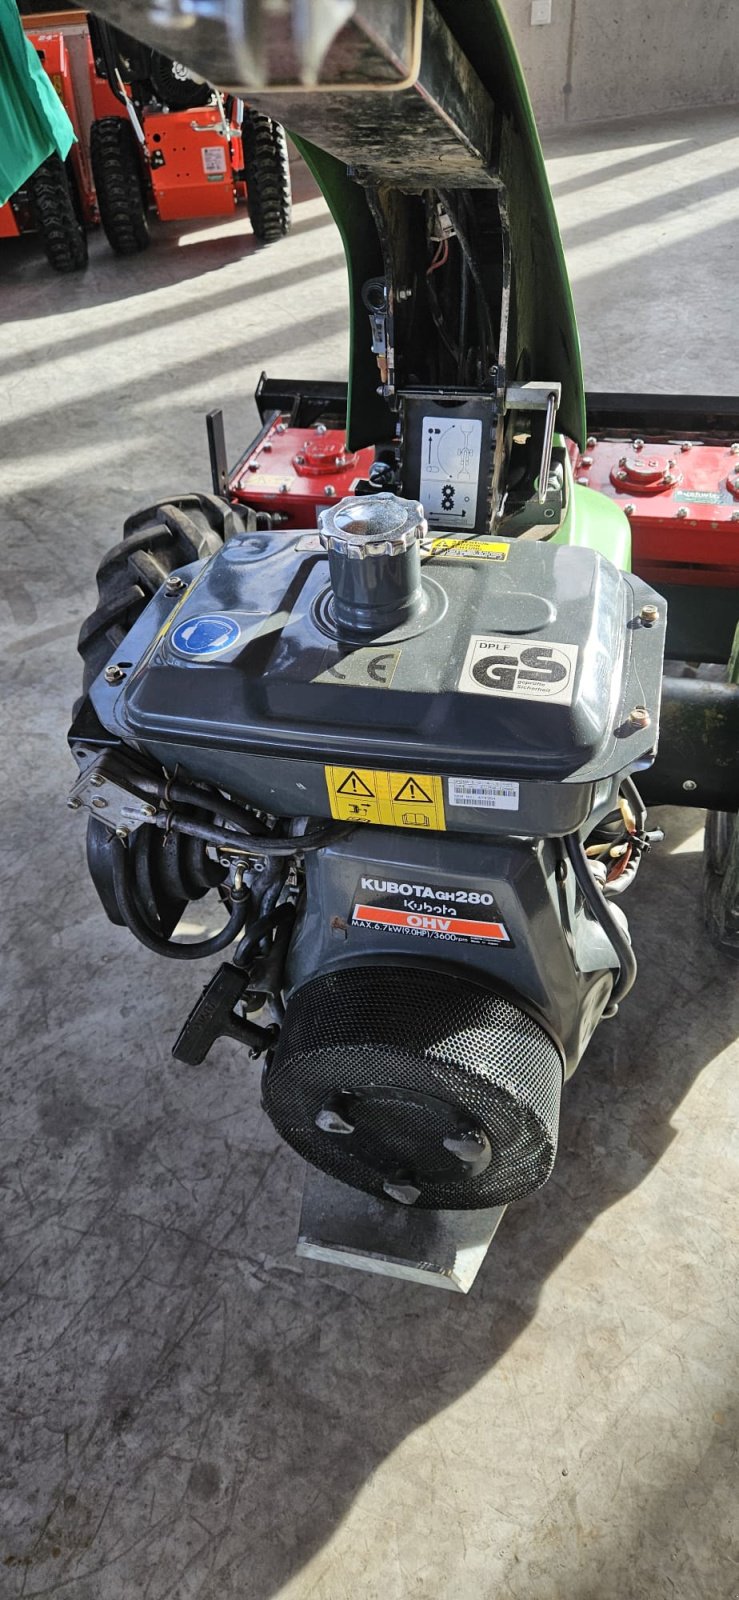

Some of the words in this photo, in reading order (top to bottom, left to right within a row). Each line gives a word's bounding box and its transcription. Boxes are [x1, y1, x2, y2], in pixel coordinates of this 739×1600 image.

[479, 642, 511, 651] DPLF
[472, 647, 568, 691] GS
[403, 899, 457, 916] Kubota
[406, 915, 452, 931] OHV
